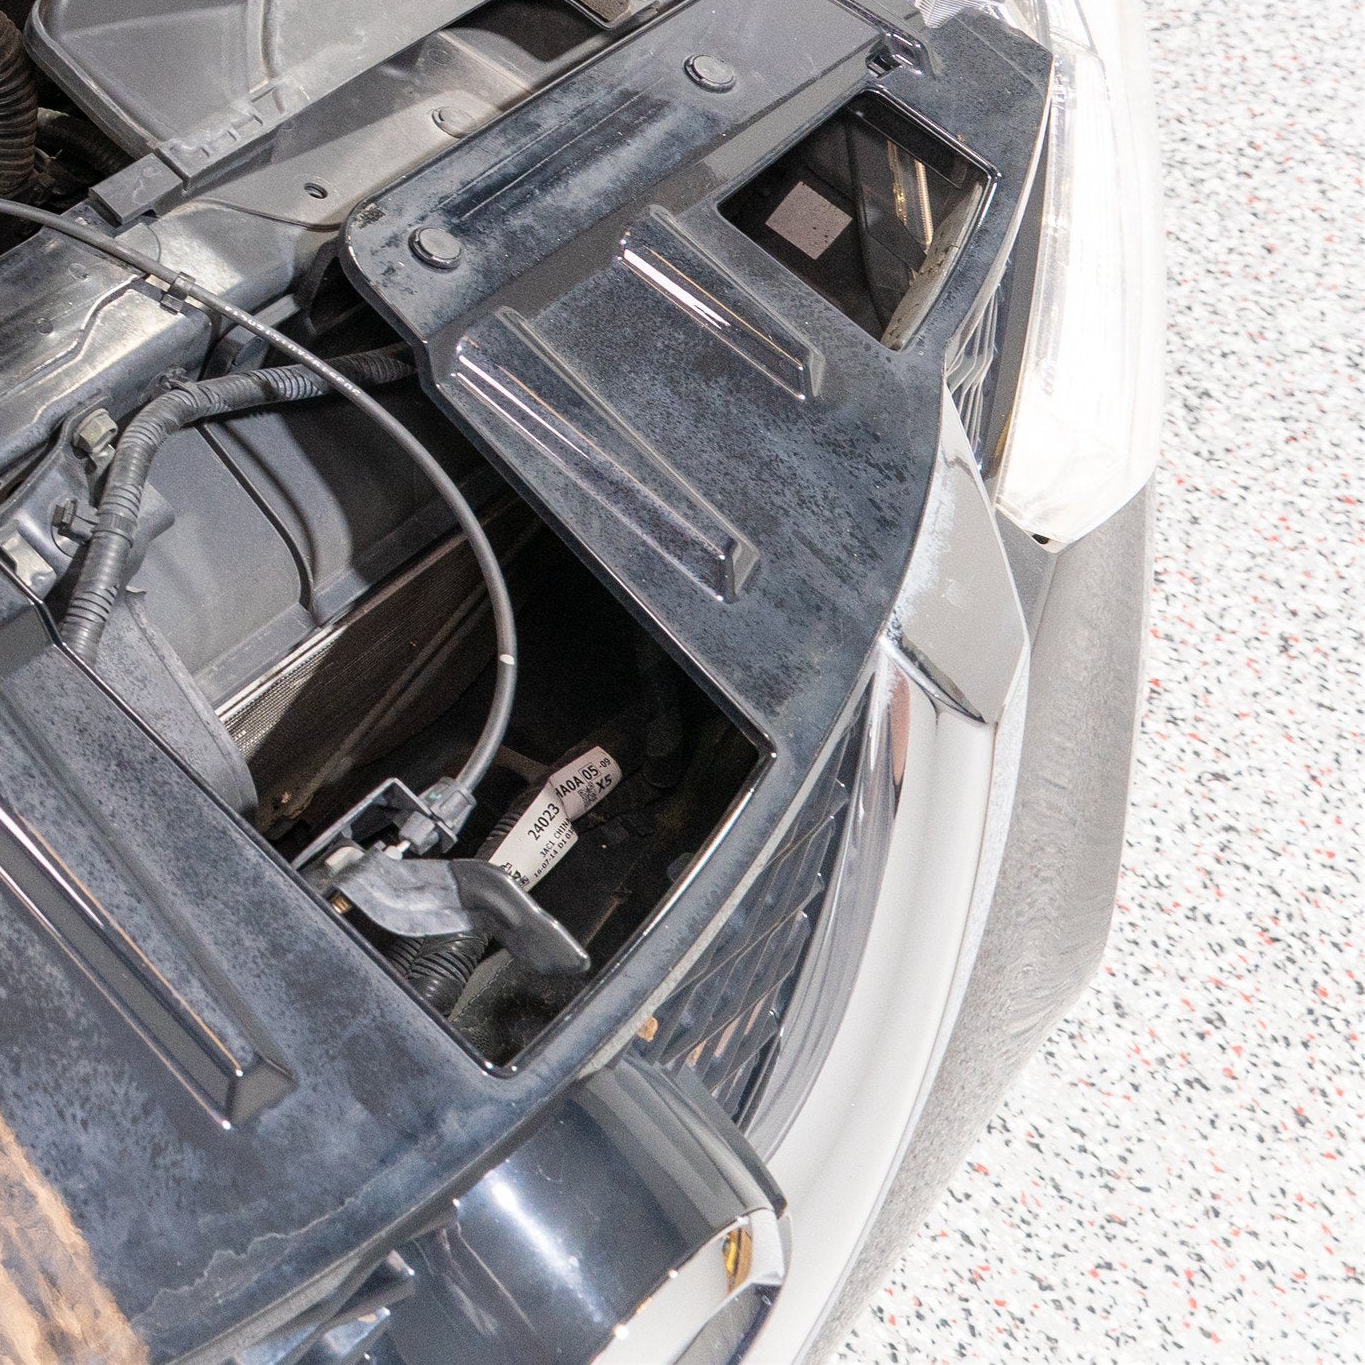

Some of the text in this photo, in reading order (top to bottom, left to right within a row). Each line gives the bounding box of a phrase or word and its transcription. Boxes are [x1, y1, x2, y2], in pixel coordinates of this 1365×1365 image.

[582, 765, 600, 781] 05
[596, 775, 614, 793] X5
[527, 803, 561, 841] 24023
